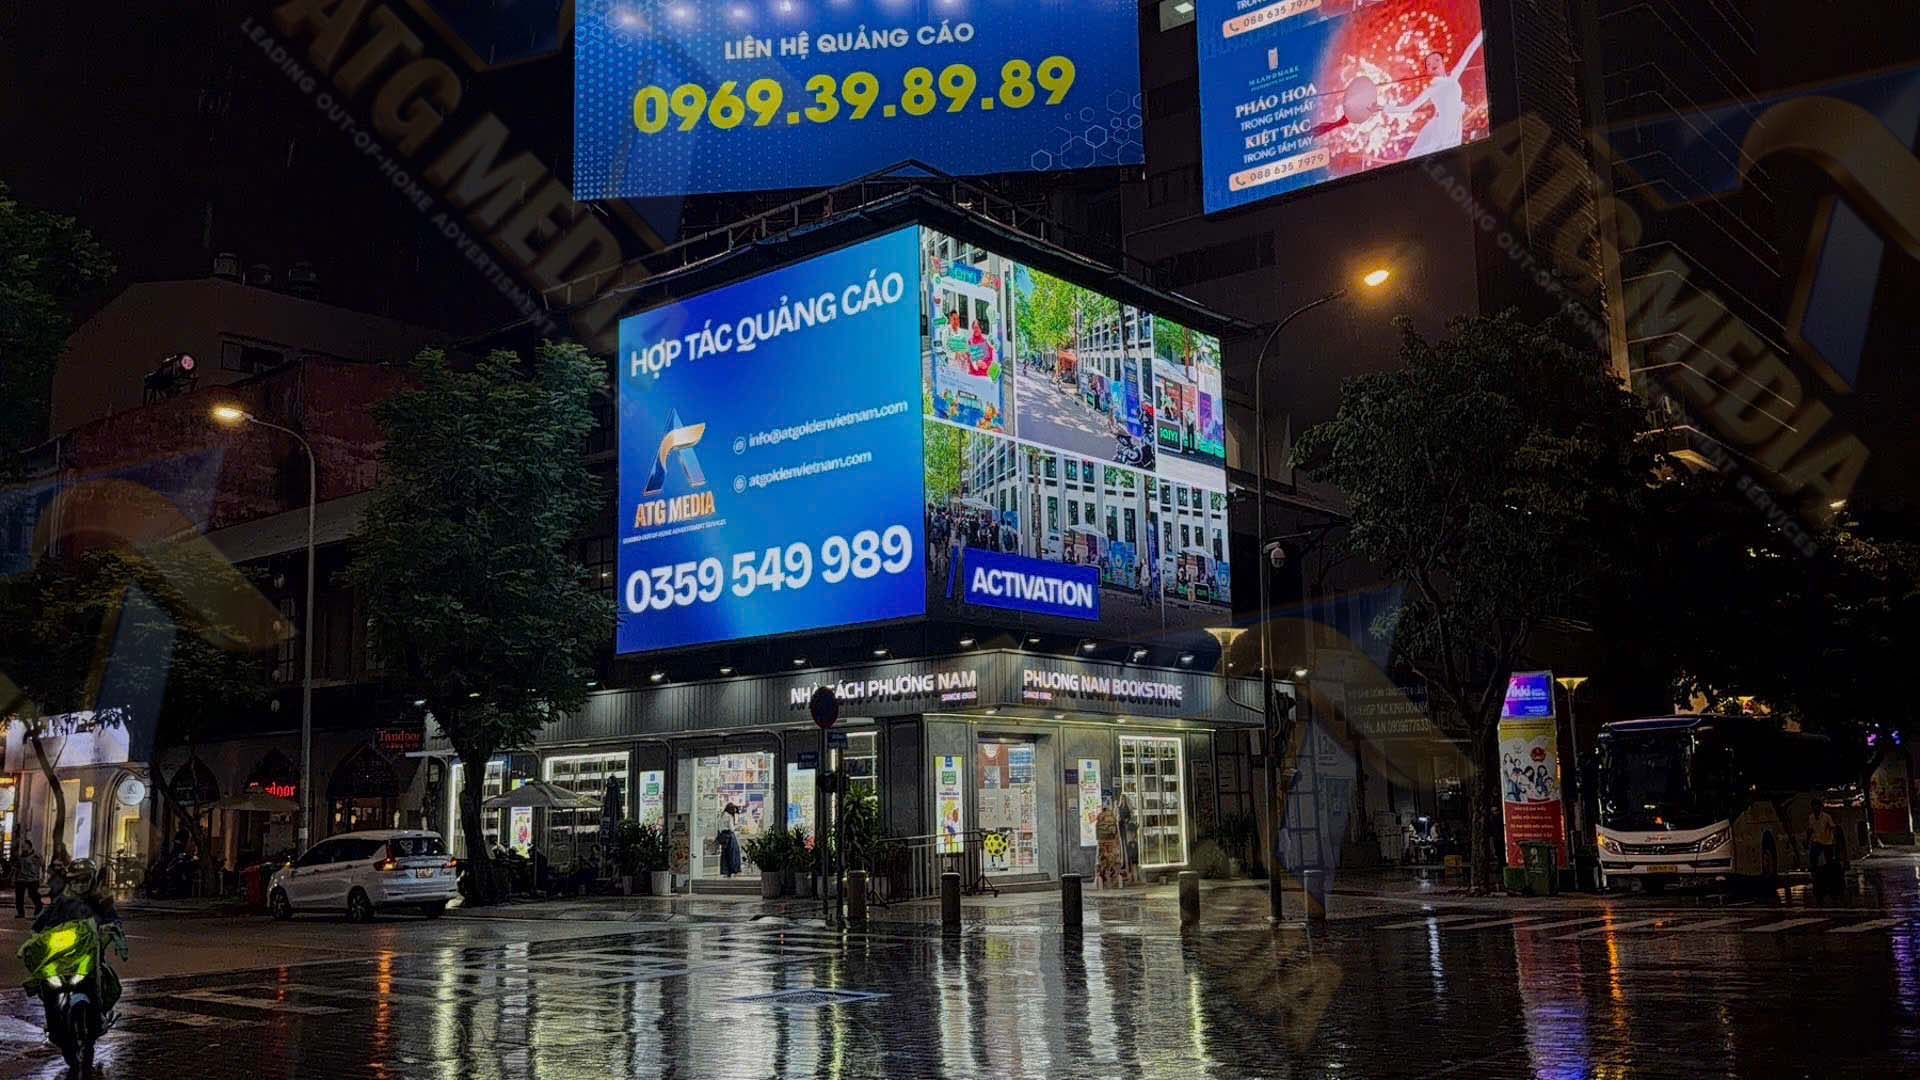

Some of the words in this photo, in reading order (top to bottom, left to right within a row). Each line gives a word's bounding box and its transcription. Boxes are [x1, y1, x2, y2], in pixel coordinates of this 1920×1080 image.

[724, 34, 772, 60] LIÊN
[780, 31, 810, 60] HỆ
[817, 24, 909, 53] QUẢNG
[916, 19, 975, 46] CÁO
[632, 55, 1077, 134] 0969.39.89.89
[1235, 95, 1278, 118] PHÁO
[1281, 82, 1318, 105] HOA
[1240, 113, 1273, 131] TRONG
[1245, 128, 1280, 149] KIỆT
[1280, 119, 1312, 139] TÁC
[1243, 147, 1277, 164] TRONG
[1274, 162, 1294, 175] 635
[631, 337, 682, 380] HỢP
[684, 319, 732, 361] TÁC
[736, 291, 837, 352] QUẢNG
[841, 268, 905, 316] CÁO
[749, 400, 908, 447] info@atgoldenvietnam.com
[749, 451, 873, 488] atgoldenvietnam.com
[634, 499, 667, 529] ATG
[668, 490, 716, 524] MEDIA
[625, 556, 724, 614] 0359
[731, 542, 813, 597] 549
[821, 524, 913, 584] 989
[971, 566, 1094, 609] ACTIVATION
[829, 679, 865, 700] ÁCH
[868, 673, 934, 698] PHƯƠNG
[937, 670, 977, 690] NAM
[1023, 669, 1079, 691] PHUONG
[1081, 675, 1110, 694] NAM
[1112, 679, 1183, 700] BOOKSTORE
